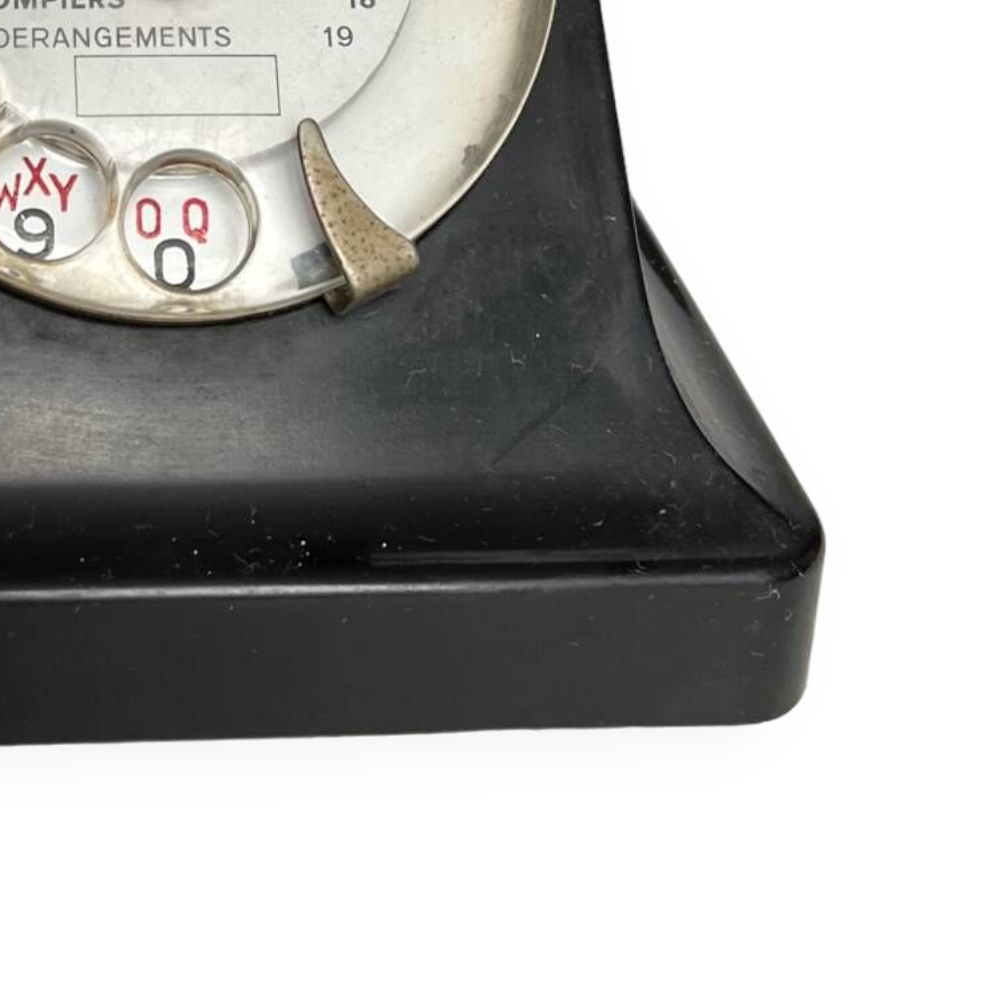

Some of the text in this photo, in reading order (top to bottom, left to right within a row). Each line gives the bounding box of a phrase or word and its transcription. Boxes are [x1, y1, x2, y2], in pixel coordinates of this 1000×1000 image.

[323, 25, 353, 47] 19
[13, 208, 55, 260] 9
[153, 238, 196, 291] 0
